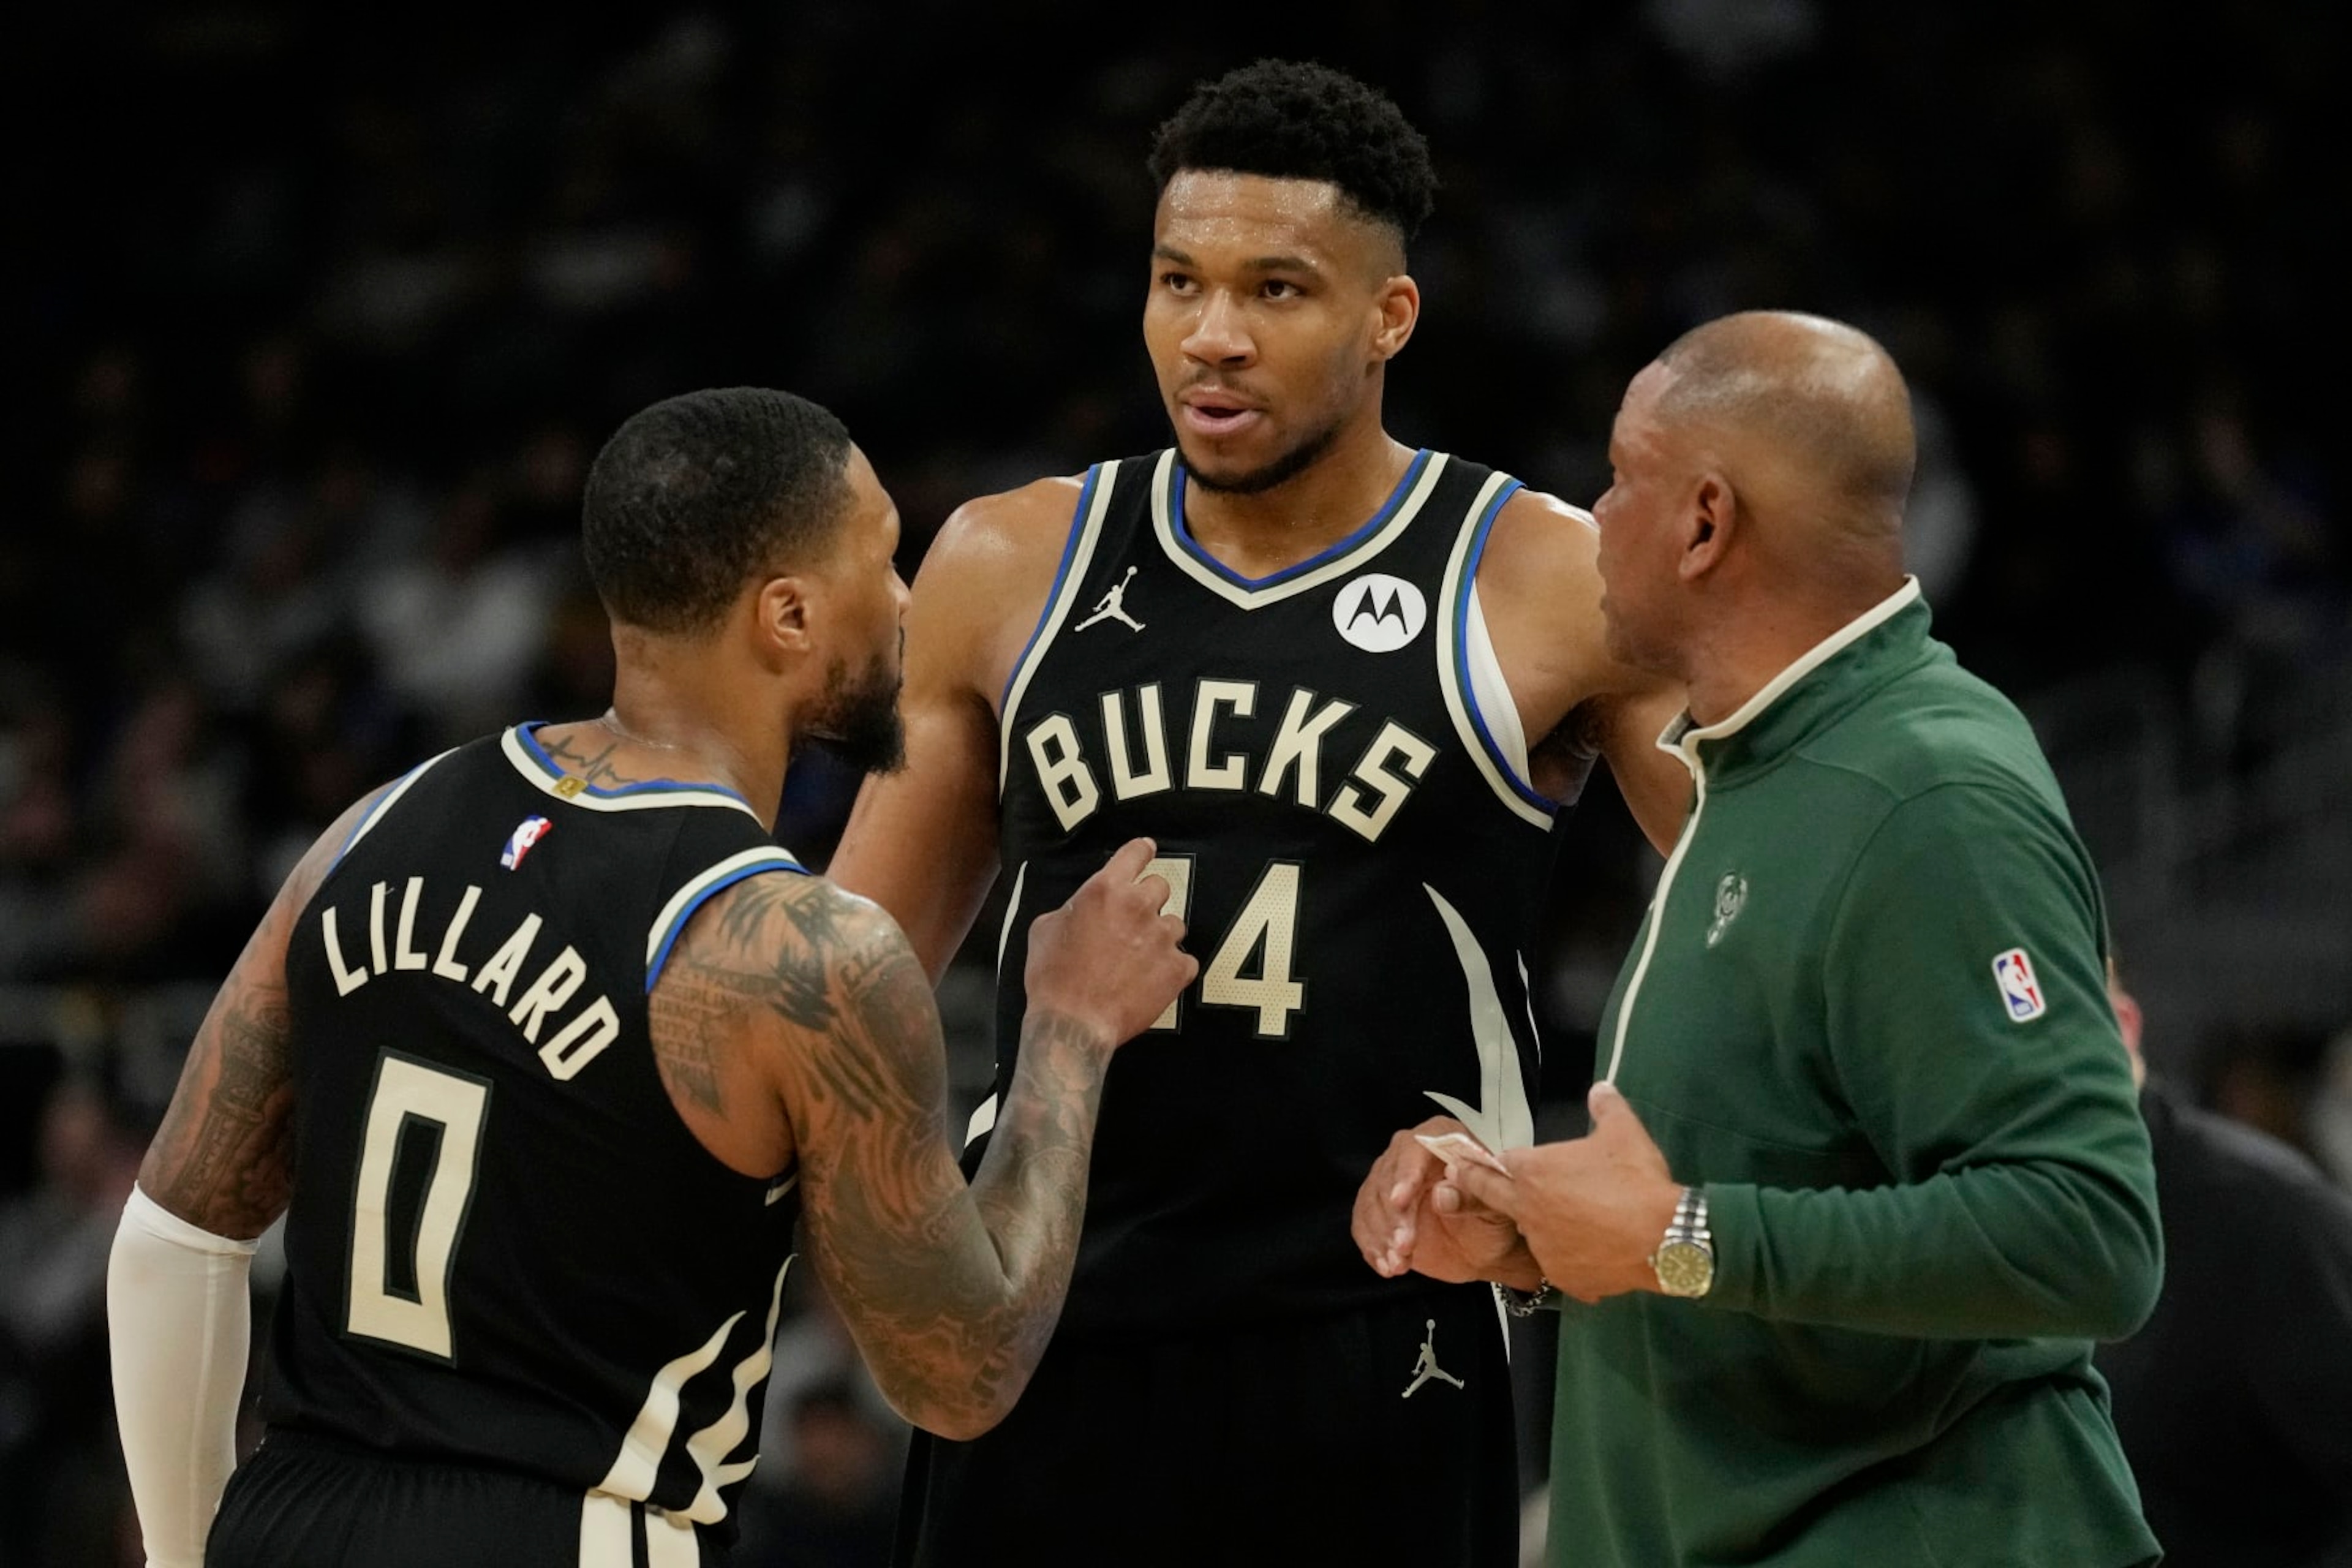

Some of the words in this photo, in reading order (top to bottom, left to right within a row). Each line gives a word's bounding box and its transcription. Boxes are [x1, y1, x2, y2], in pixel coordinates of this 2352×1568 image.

[1026, 679, 1438, 843] BUCKS
[322, 876, 620, 1081] LILLARD
[347, 1056, 487, 1359] 0
